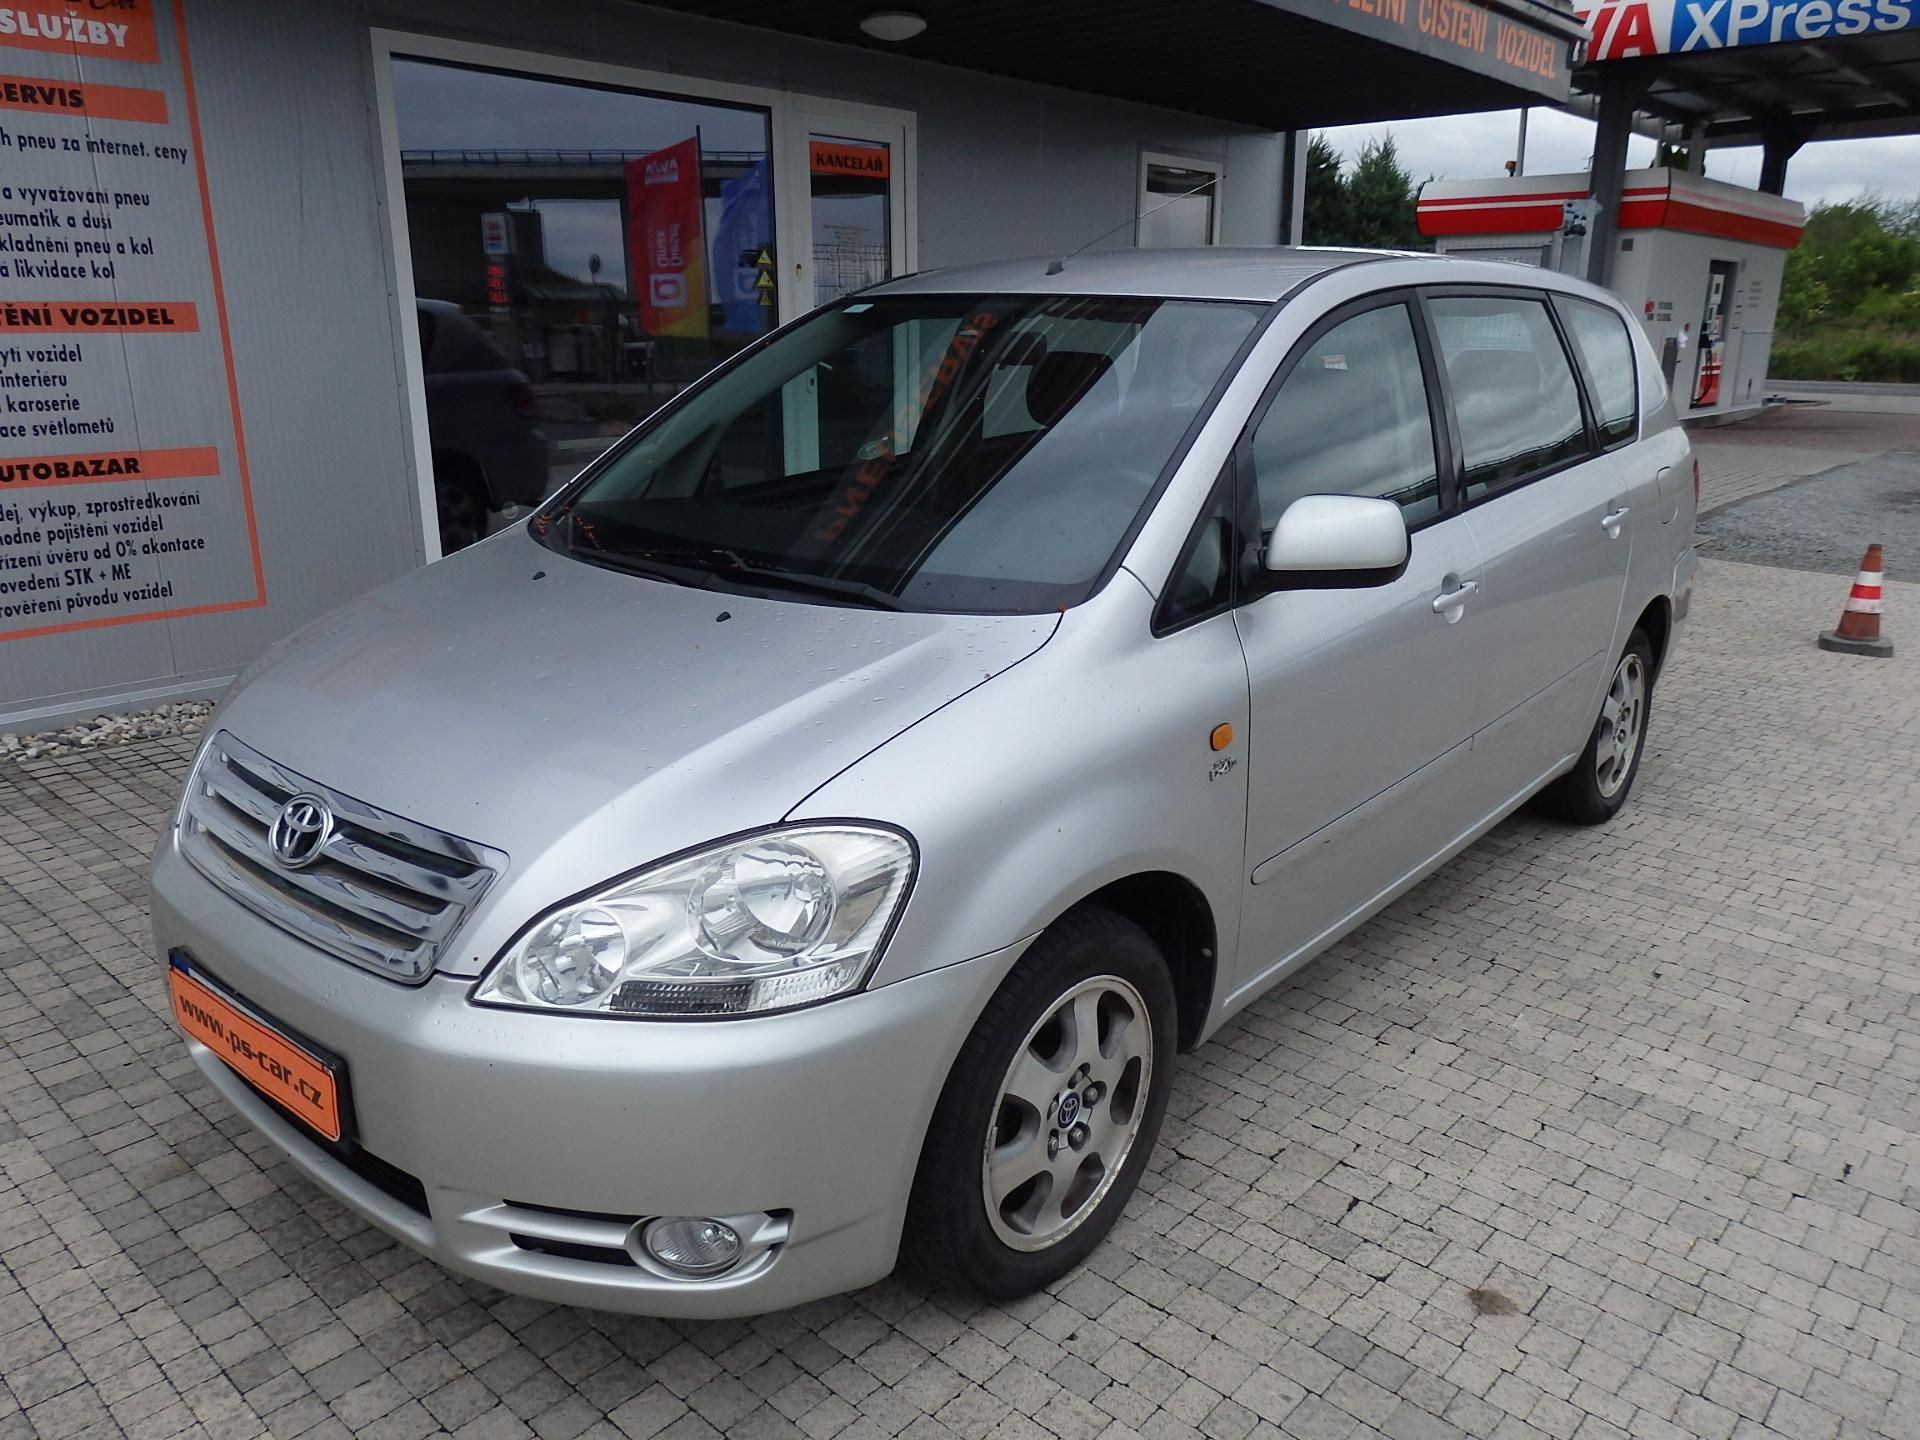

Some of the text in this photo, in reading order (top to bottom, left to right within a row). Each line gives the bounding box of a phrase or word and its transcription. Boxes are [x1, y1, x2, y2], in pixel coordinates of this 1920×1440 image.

[0, 9, 129, 48] SLUŽBY
[1496, 21, 1556, 79] VOZIDEL
[0, 82, 84, 108] ERVIS
[16, 133, 56, 153] pneu
[61, 137, 81, 152] za
[84, 133, 151, 158] internet.
[154, 144, 189, 165] ceny
[816, 152, 884, 172] KANCELÁŘ
[2, 185, 150, 210] a vyvažování pneu
[66, 216, 77, 229] a
[73, 239, 111, 258] pneu
[116, 241, 126, 254] a
[129, 236, 154, 256] kol
[13, 257, 87, 279] likvidace
[91, 260, 116, 279] kol
[0, 303, 175, 327] ĚNÍ VOZIDEL
[26, 343, 82, 364] vozidel
[6, 393, 81, 414] karoserie
[31, 415, 115, 437] světlometů
[86, 489, 201, 516] zprostředkování
[46, 520, 109, 546] pojištění
[112, 513, 164, 534] vozidel
[93, 541, 112, 560] od
[115, 536, 138, 558] 0%
[141, 536, 206, 555] akontace
[64, 565, 95, 587] STK
[98, 570, 107, 582] +
[112, 562, 133, 582] ME
[65, 587, 118, 614] původu
[122, 580, 173, 602] vozidel
[179, 993, 325, 1111] www.ps-car.cz
